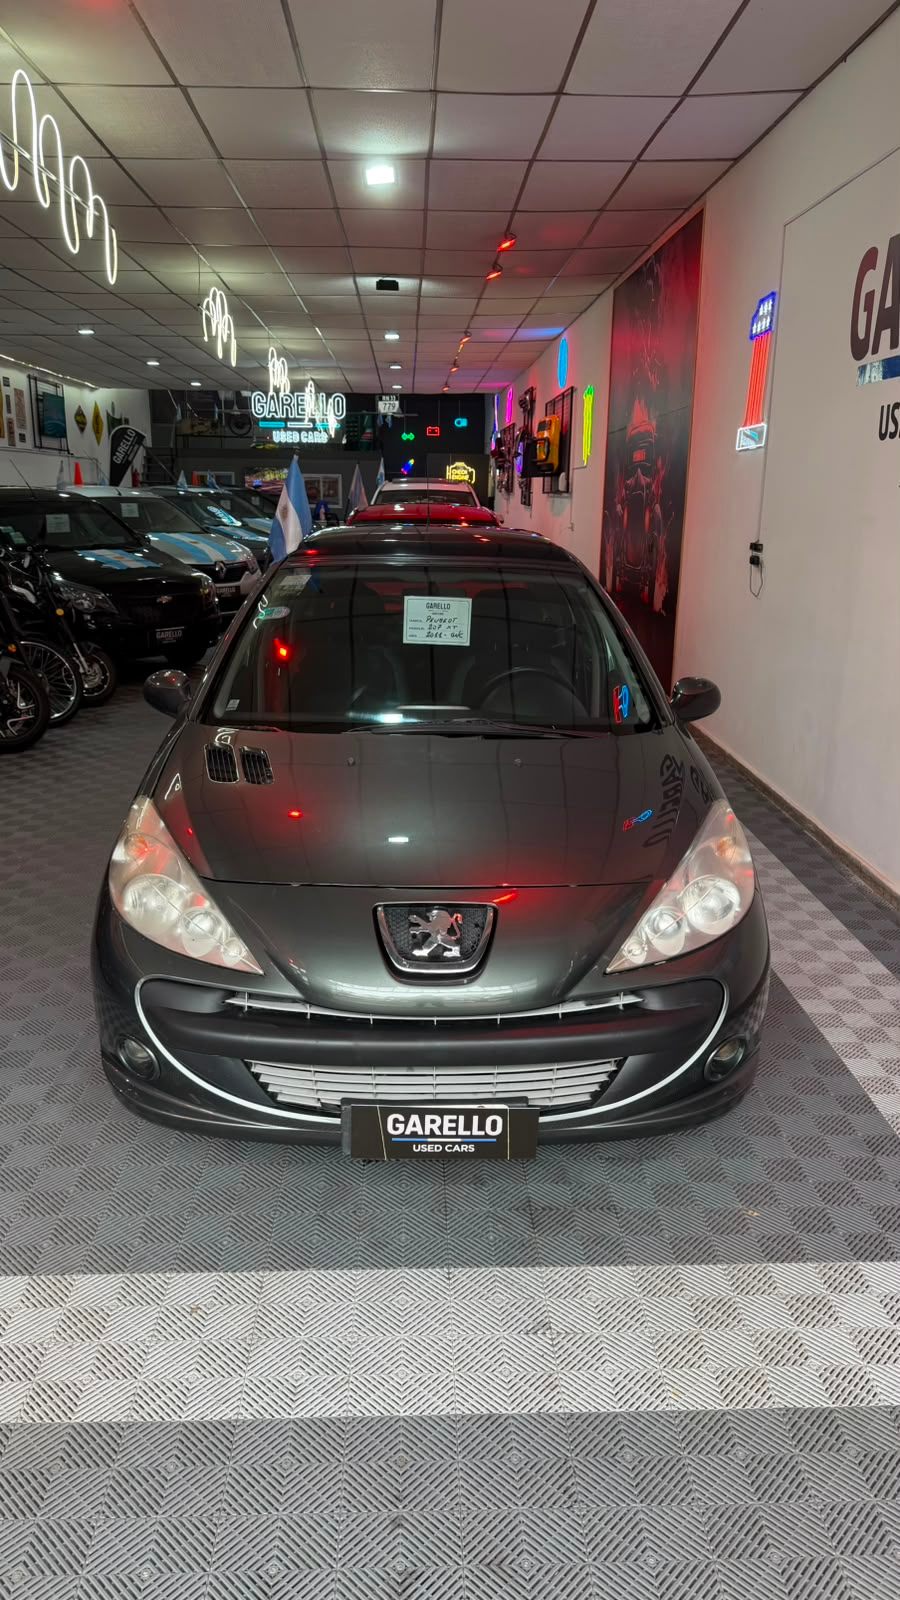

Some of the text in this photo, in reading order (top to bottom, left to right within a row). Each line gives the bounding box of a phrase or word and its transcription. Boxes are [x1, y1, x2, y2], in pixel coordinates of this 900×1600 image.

[251, 391, 346, 420] GARELLO
[878, 401, 900, 441] US
[272, 430, 329, 443] USED CARS
[112, 429, 136, 464] GARELLO
[425, 602, 451, 610] GARELLO
[156, 630, 182, 639] GARELLO
[386, 1113, 503, 1136] GARELLO
[412, 1144, 475, 1153] USED CARS
